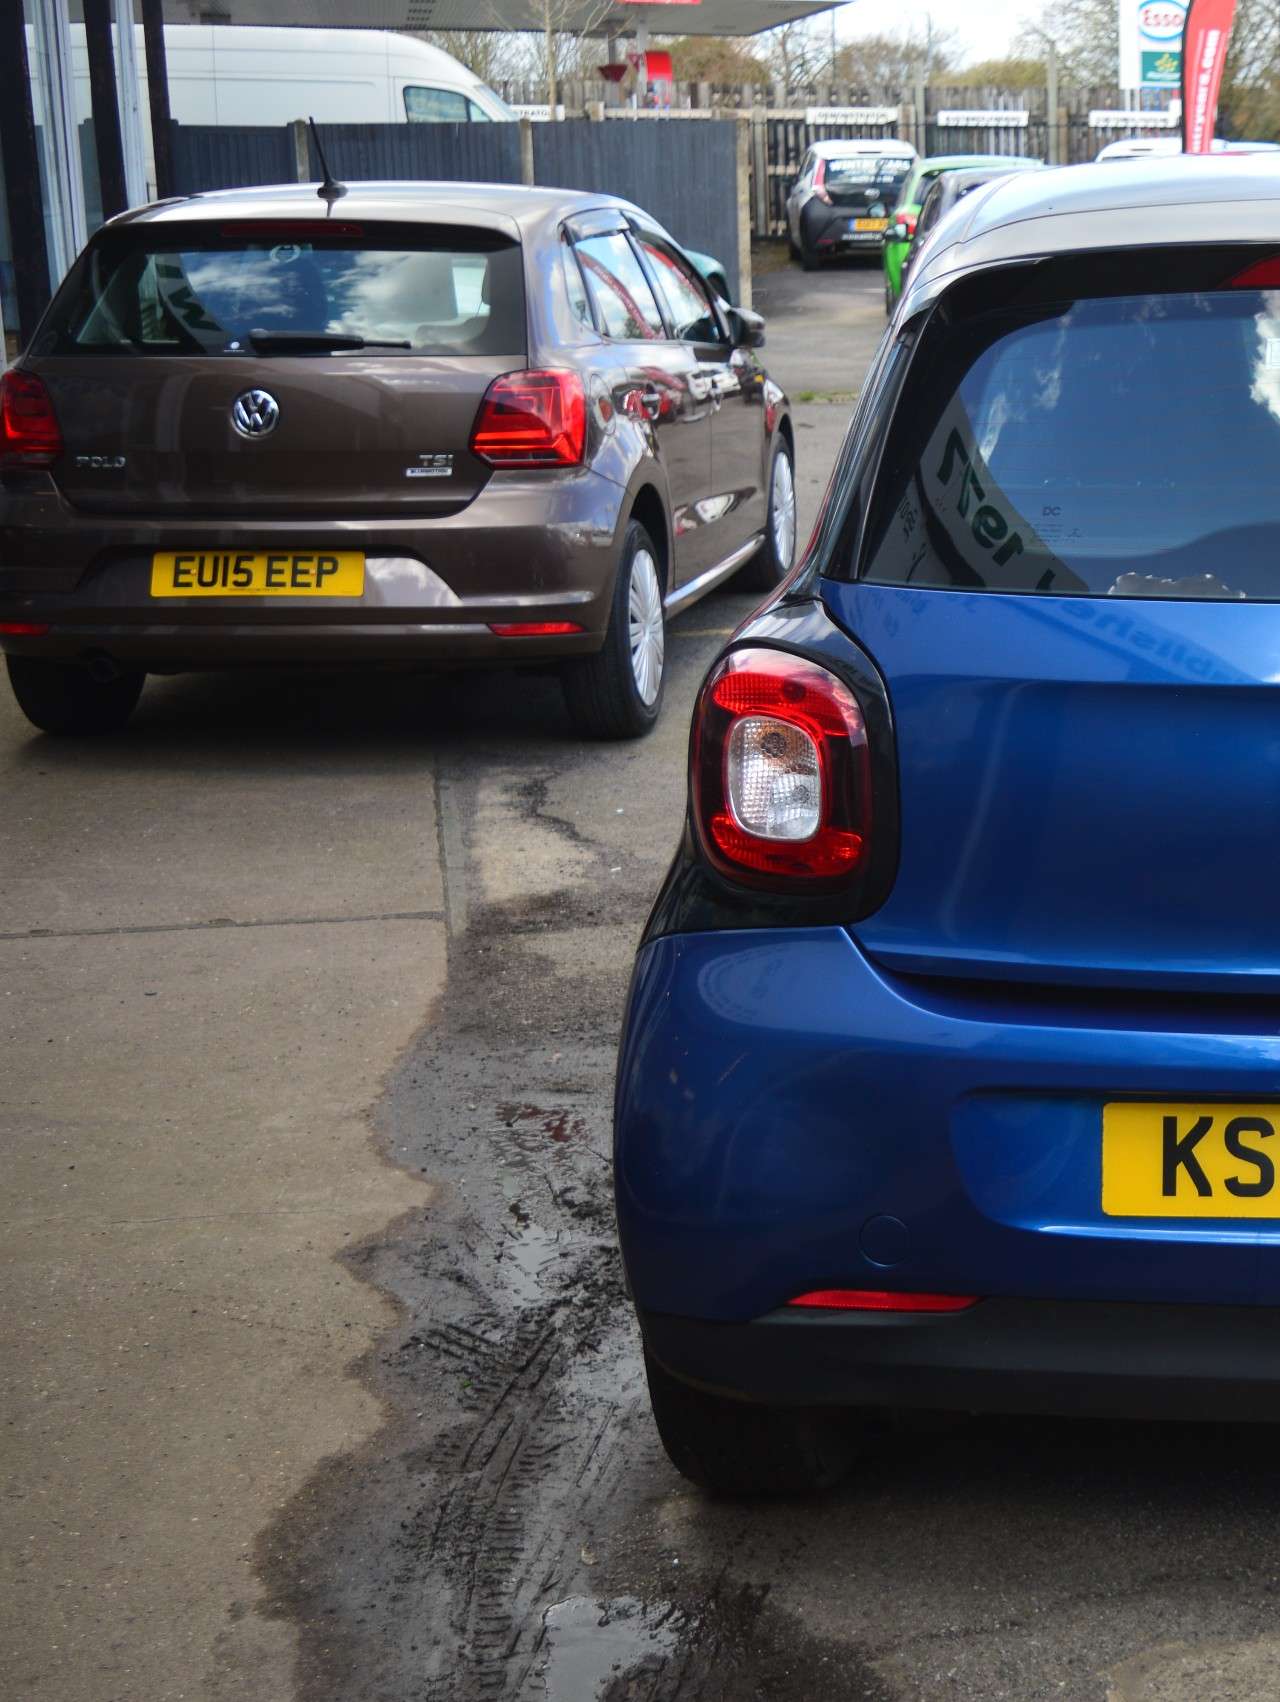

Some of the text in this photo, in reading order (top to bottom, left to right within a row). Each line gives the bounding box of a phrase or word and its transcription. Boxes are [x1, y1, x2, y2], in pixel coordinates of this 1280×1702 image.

[1143, 8, 1183, 27] Esso
[76, 455, 127, 468] POLO
[419, 454, 454, 467] TSI
[172, 555, 339, 588] EU15 EEP
